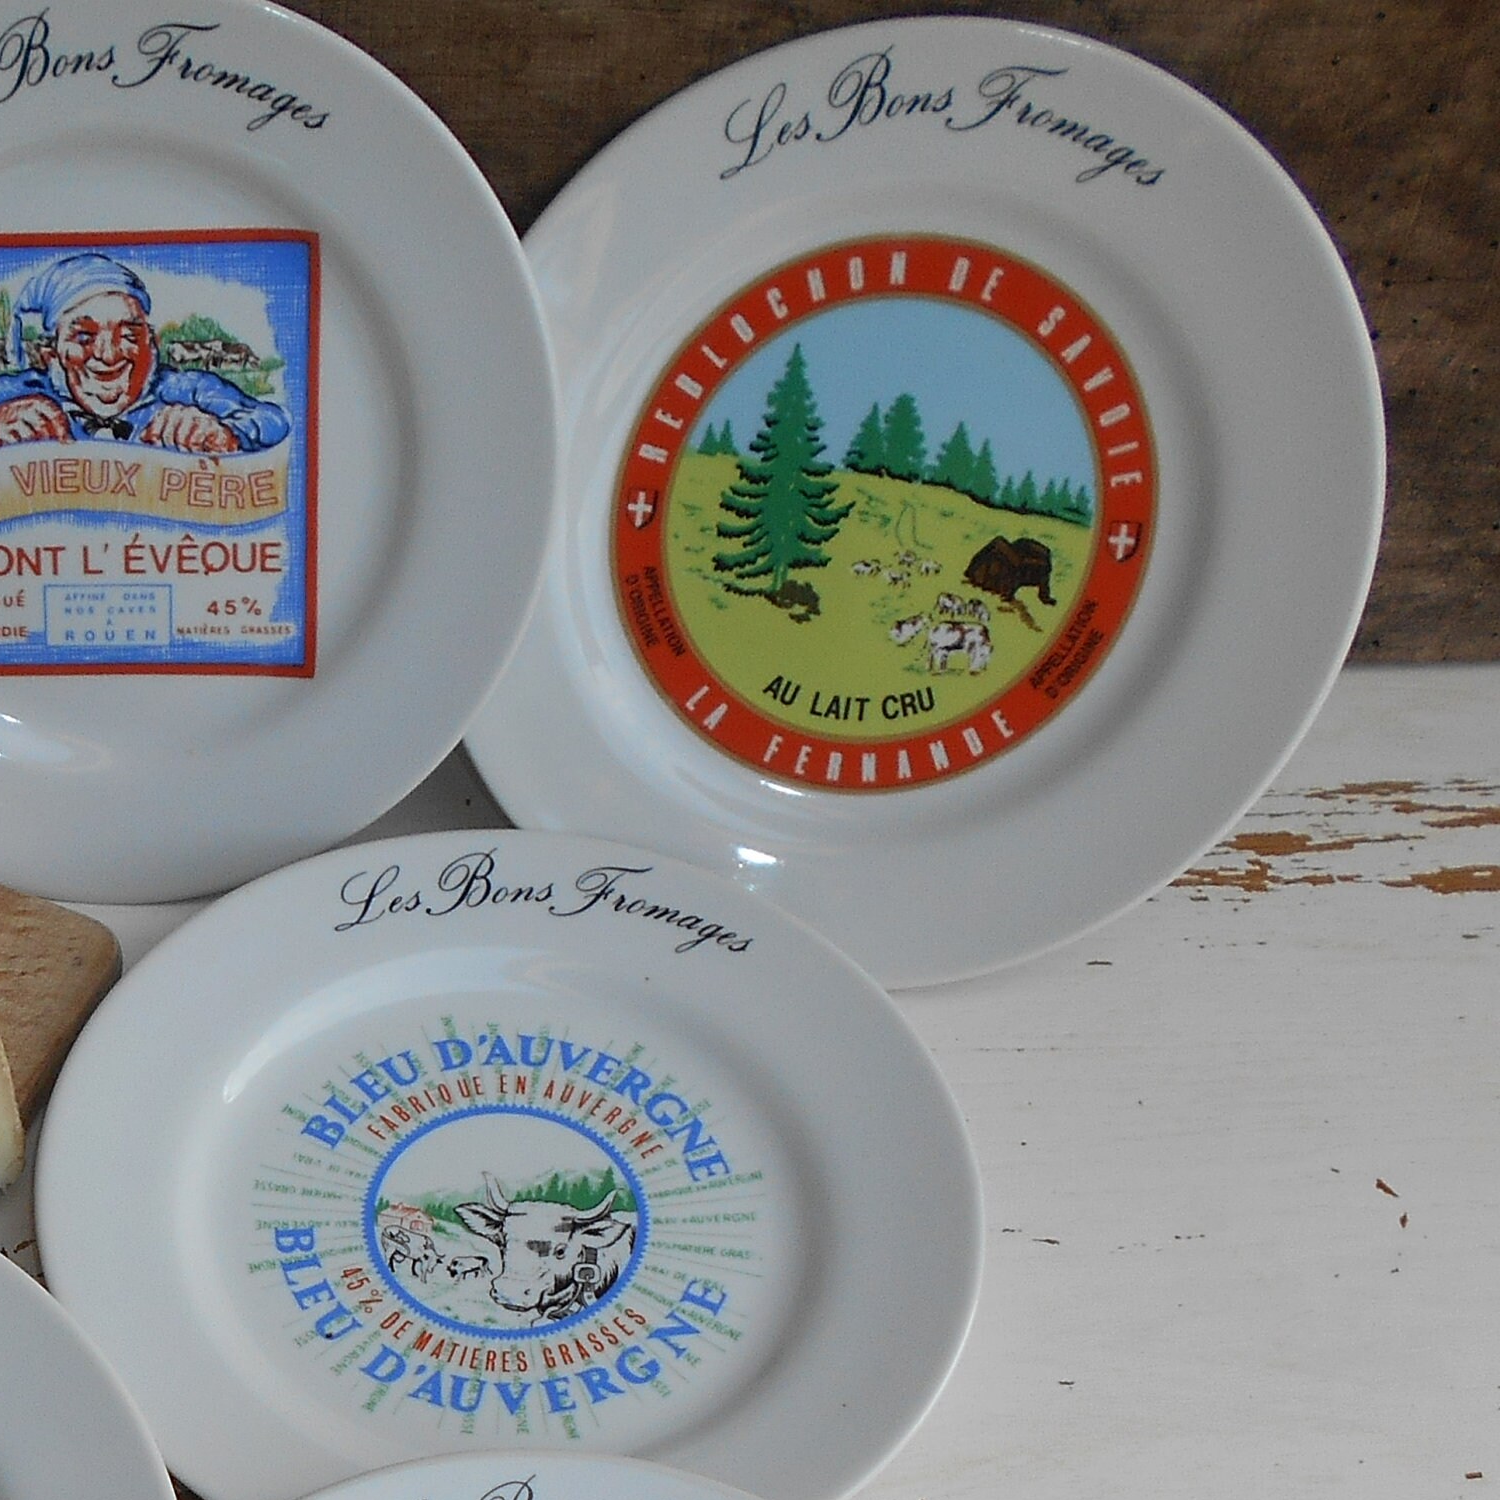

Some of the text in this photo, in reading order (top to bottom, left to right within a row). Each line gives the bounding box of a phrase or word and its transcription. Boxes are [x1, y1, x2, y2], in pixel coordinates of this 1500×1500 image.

[111, 23, 329, 131] Fromages
[720, 44, 1165, 186] Les Bons Fromages
[638, 251, 1143, 488] REBLOCHON DE SAVOIE
[11, 459, 142, 497] VIEUX
[160, 456, 279, 509] PÈRE
[123, 533, 282, 577] ÉVÊQUE
[65, 606, 156, 614] NOS CAVES
[65, 630, 156, 641] ROUEN
[207, 597, 262, 616] 45%
[240, 625, 292, 635] GRASSES
[644, 566, 686, 657] APPELLATION
[1029, 600, 1098, 689] APPELLATION
[686, 685, 728, 730] LA
[763, 675, 935, 721] AU LAIT CRU
[334, 847, 753, 953] Les Bons Fromages
[301, 1050, 423, 1149] BLEU
[432, 1033, 730, 1182] D'AUVERGNE
[367, 1075, 484, 1141] FABRIQUE
[500, 1074, 528, 1095] EN
[543, 1080, 663, 1160] AUVERGNE
[274, 1227, 362, 1340] BLEU
[361, 1280, 727, 1415] D'AUVERGNE
[381, 1310, 413, 1341] DE
[413, 1331, 528, 1373] MATIERES
[544, 1307, 646, 1368] GRASSES
